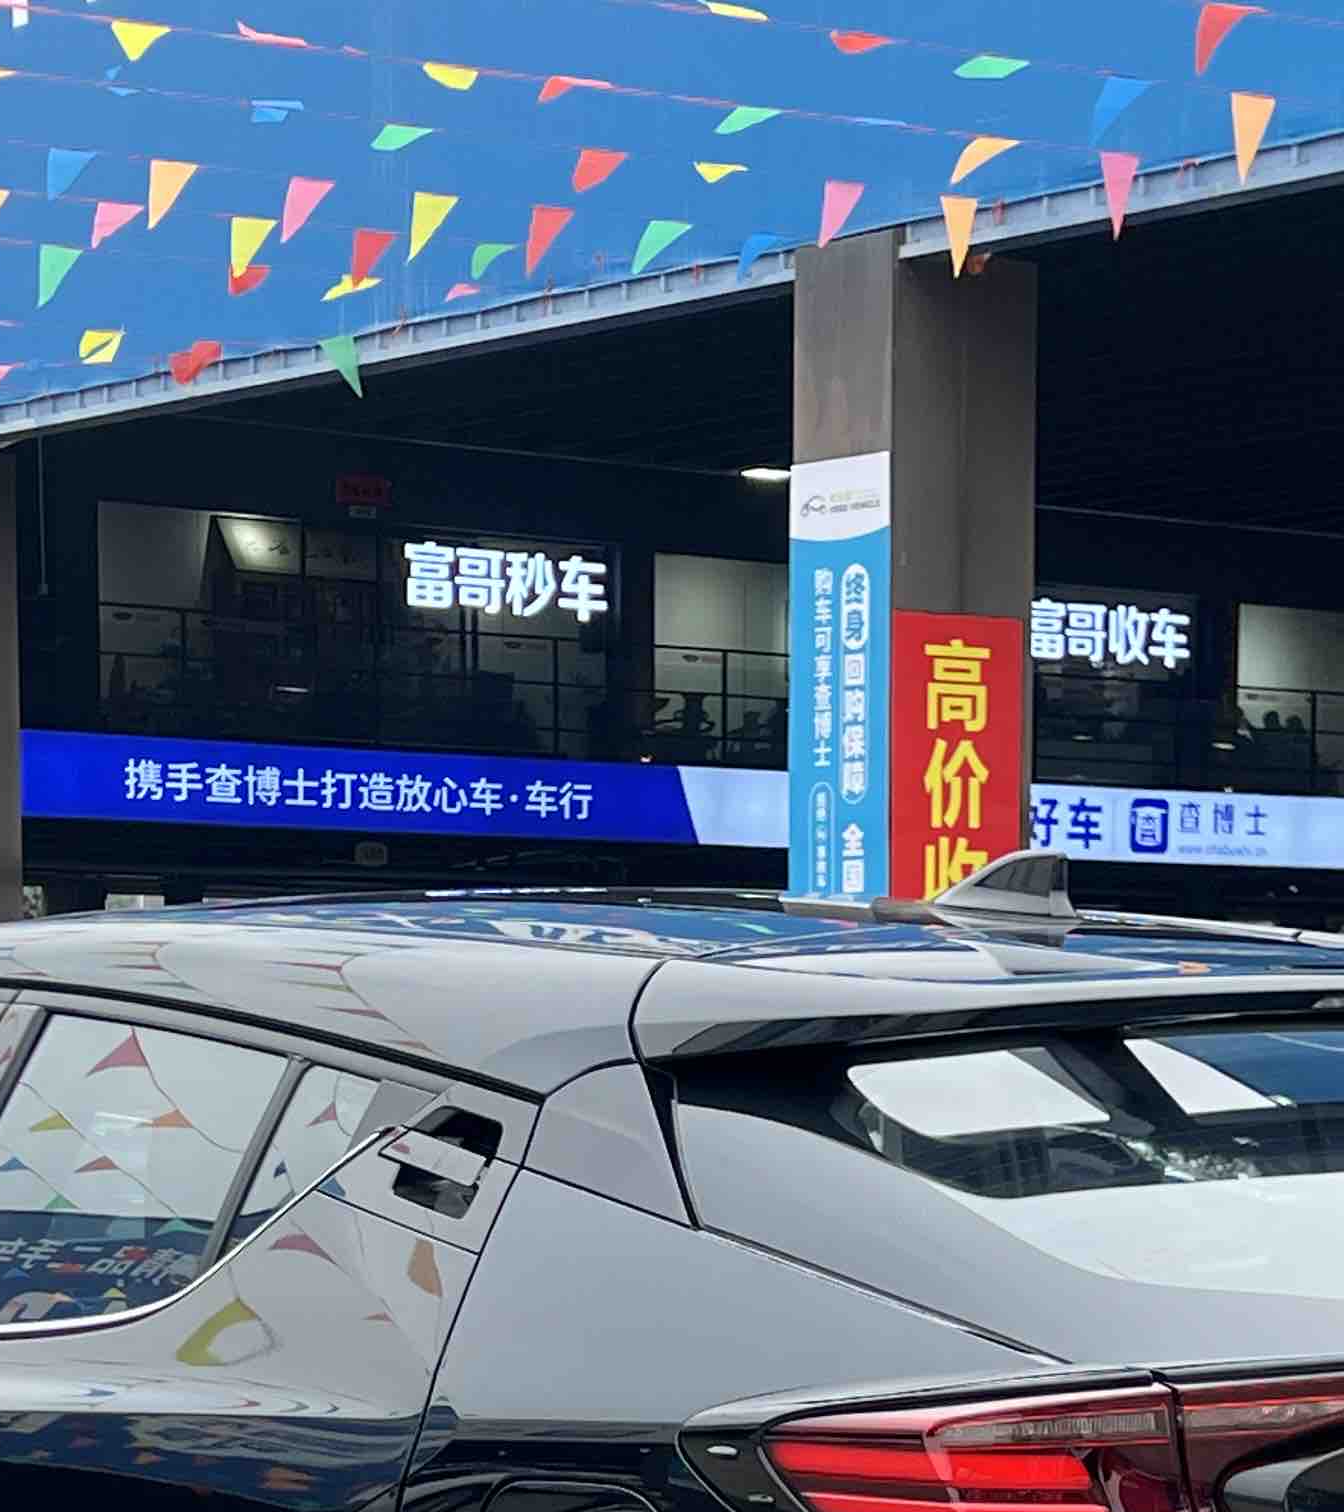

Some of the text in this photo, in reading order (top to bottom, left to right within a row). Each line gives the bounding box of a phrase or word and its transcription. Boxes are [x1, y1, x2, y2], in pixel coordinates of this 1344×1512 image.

[404, 541, 609, 623] 富哥秒车
[1029, 598, 1191, 669] 富哥收车
[923, 639, 991, 900] 高价收
[1177, 802, 1268, 836] 查博士
